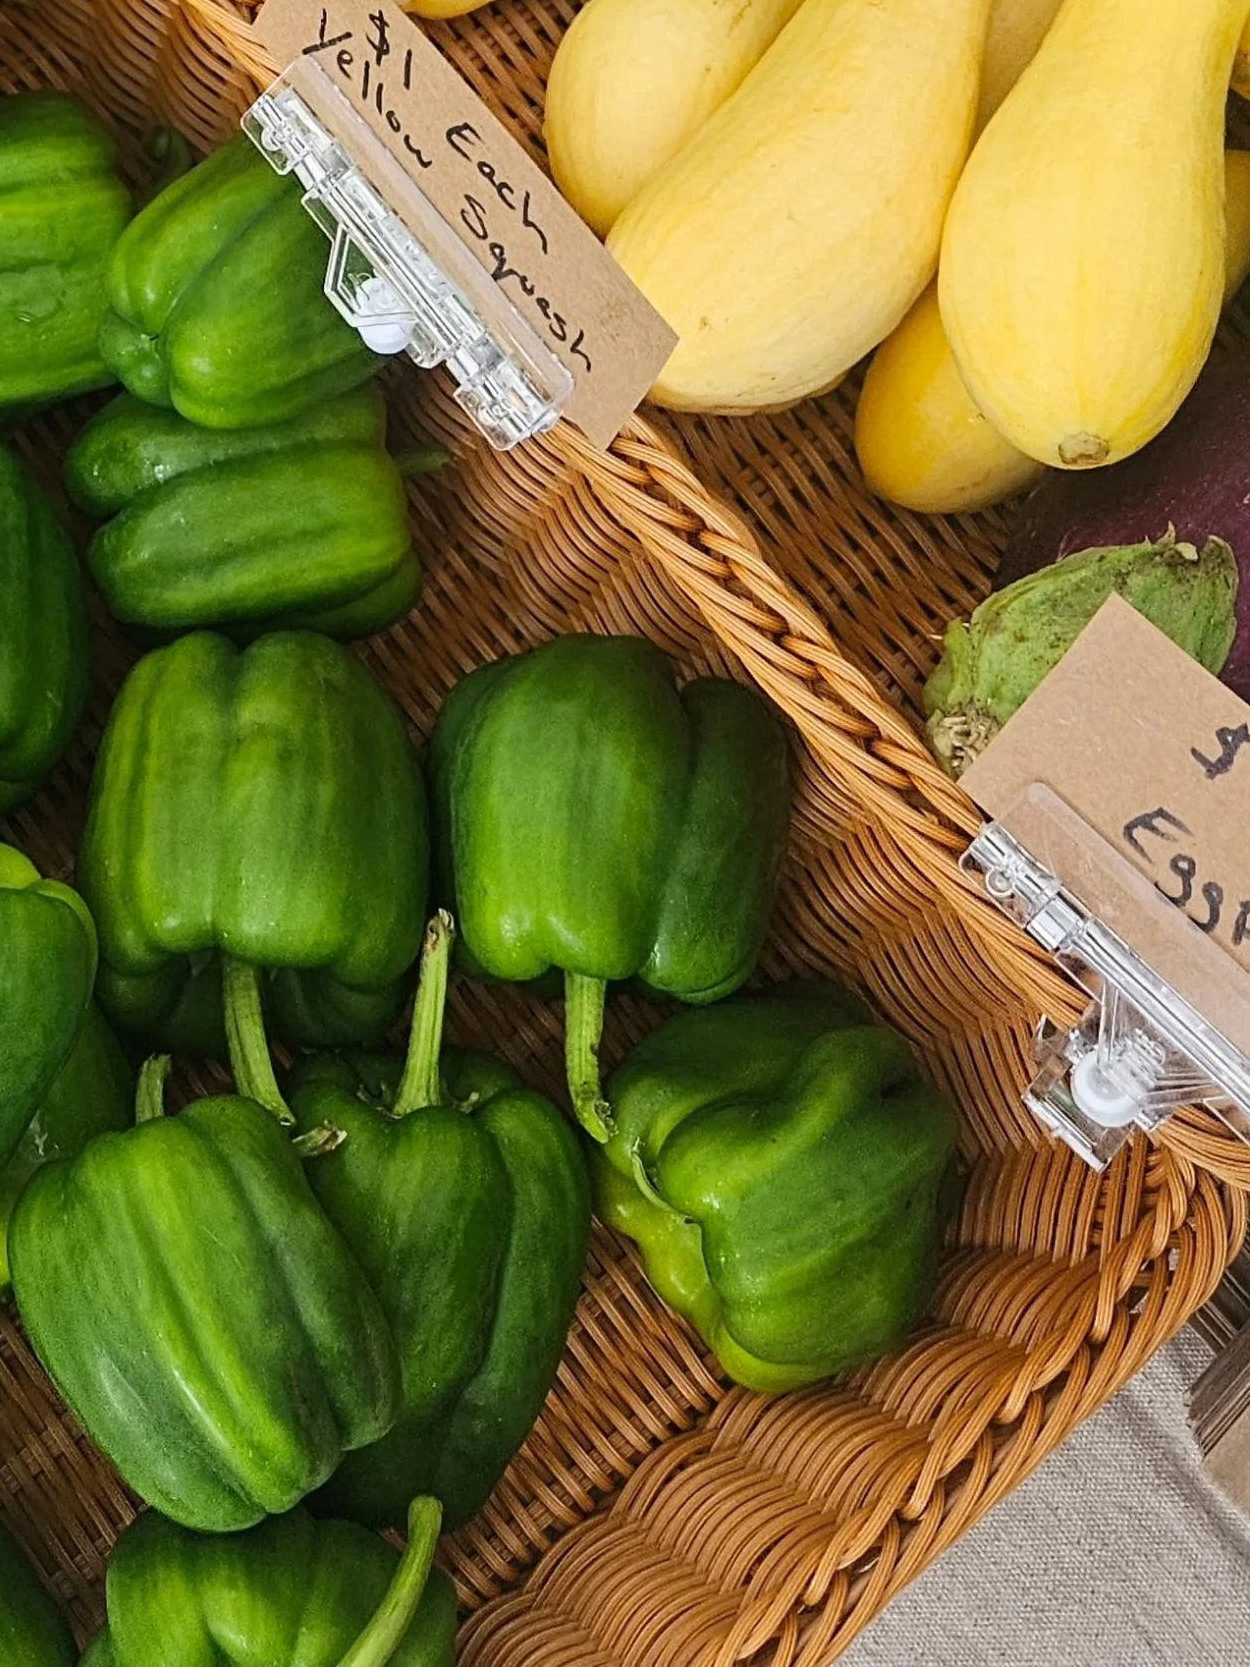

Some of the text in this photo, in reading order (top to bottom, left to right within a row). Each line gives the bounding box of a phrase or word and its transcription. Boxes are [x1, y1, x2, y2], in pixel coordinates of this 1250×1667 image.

[301, 7, 593, 373] Yellow Squash
[365, 9, 548, 255] $1 Each
